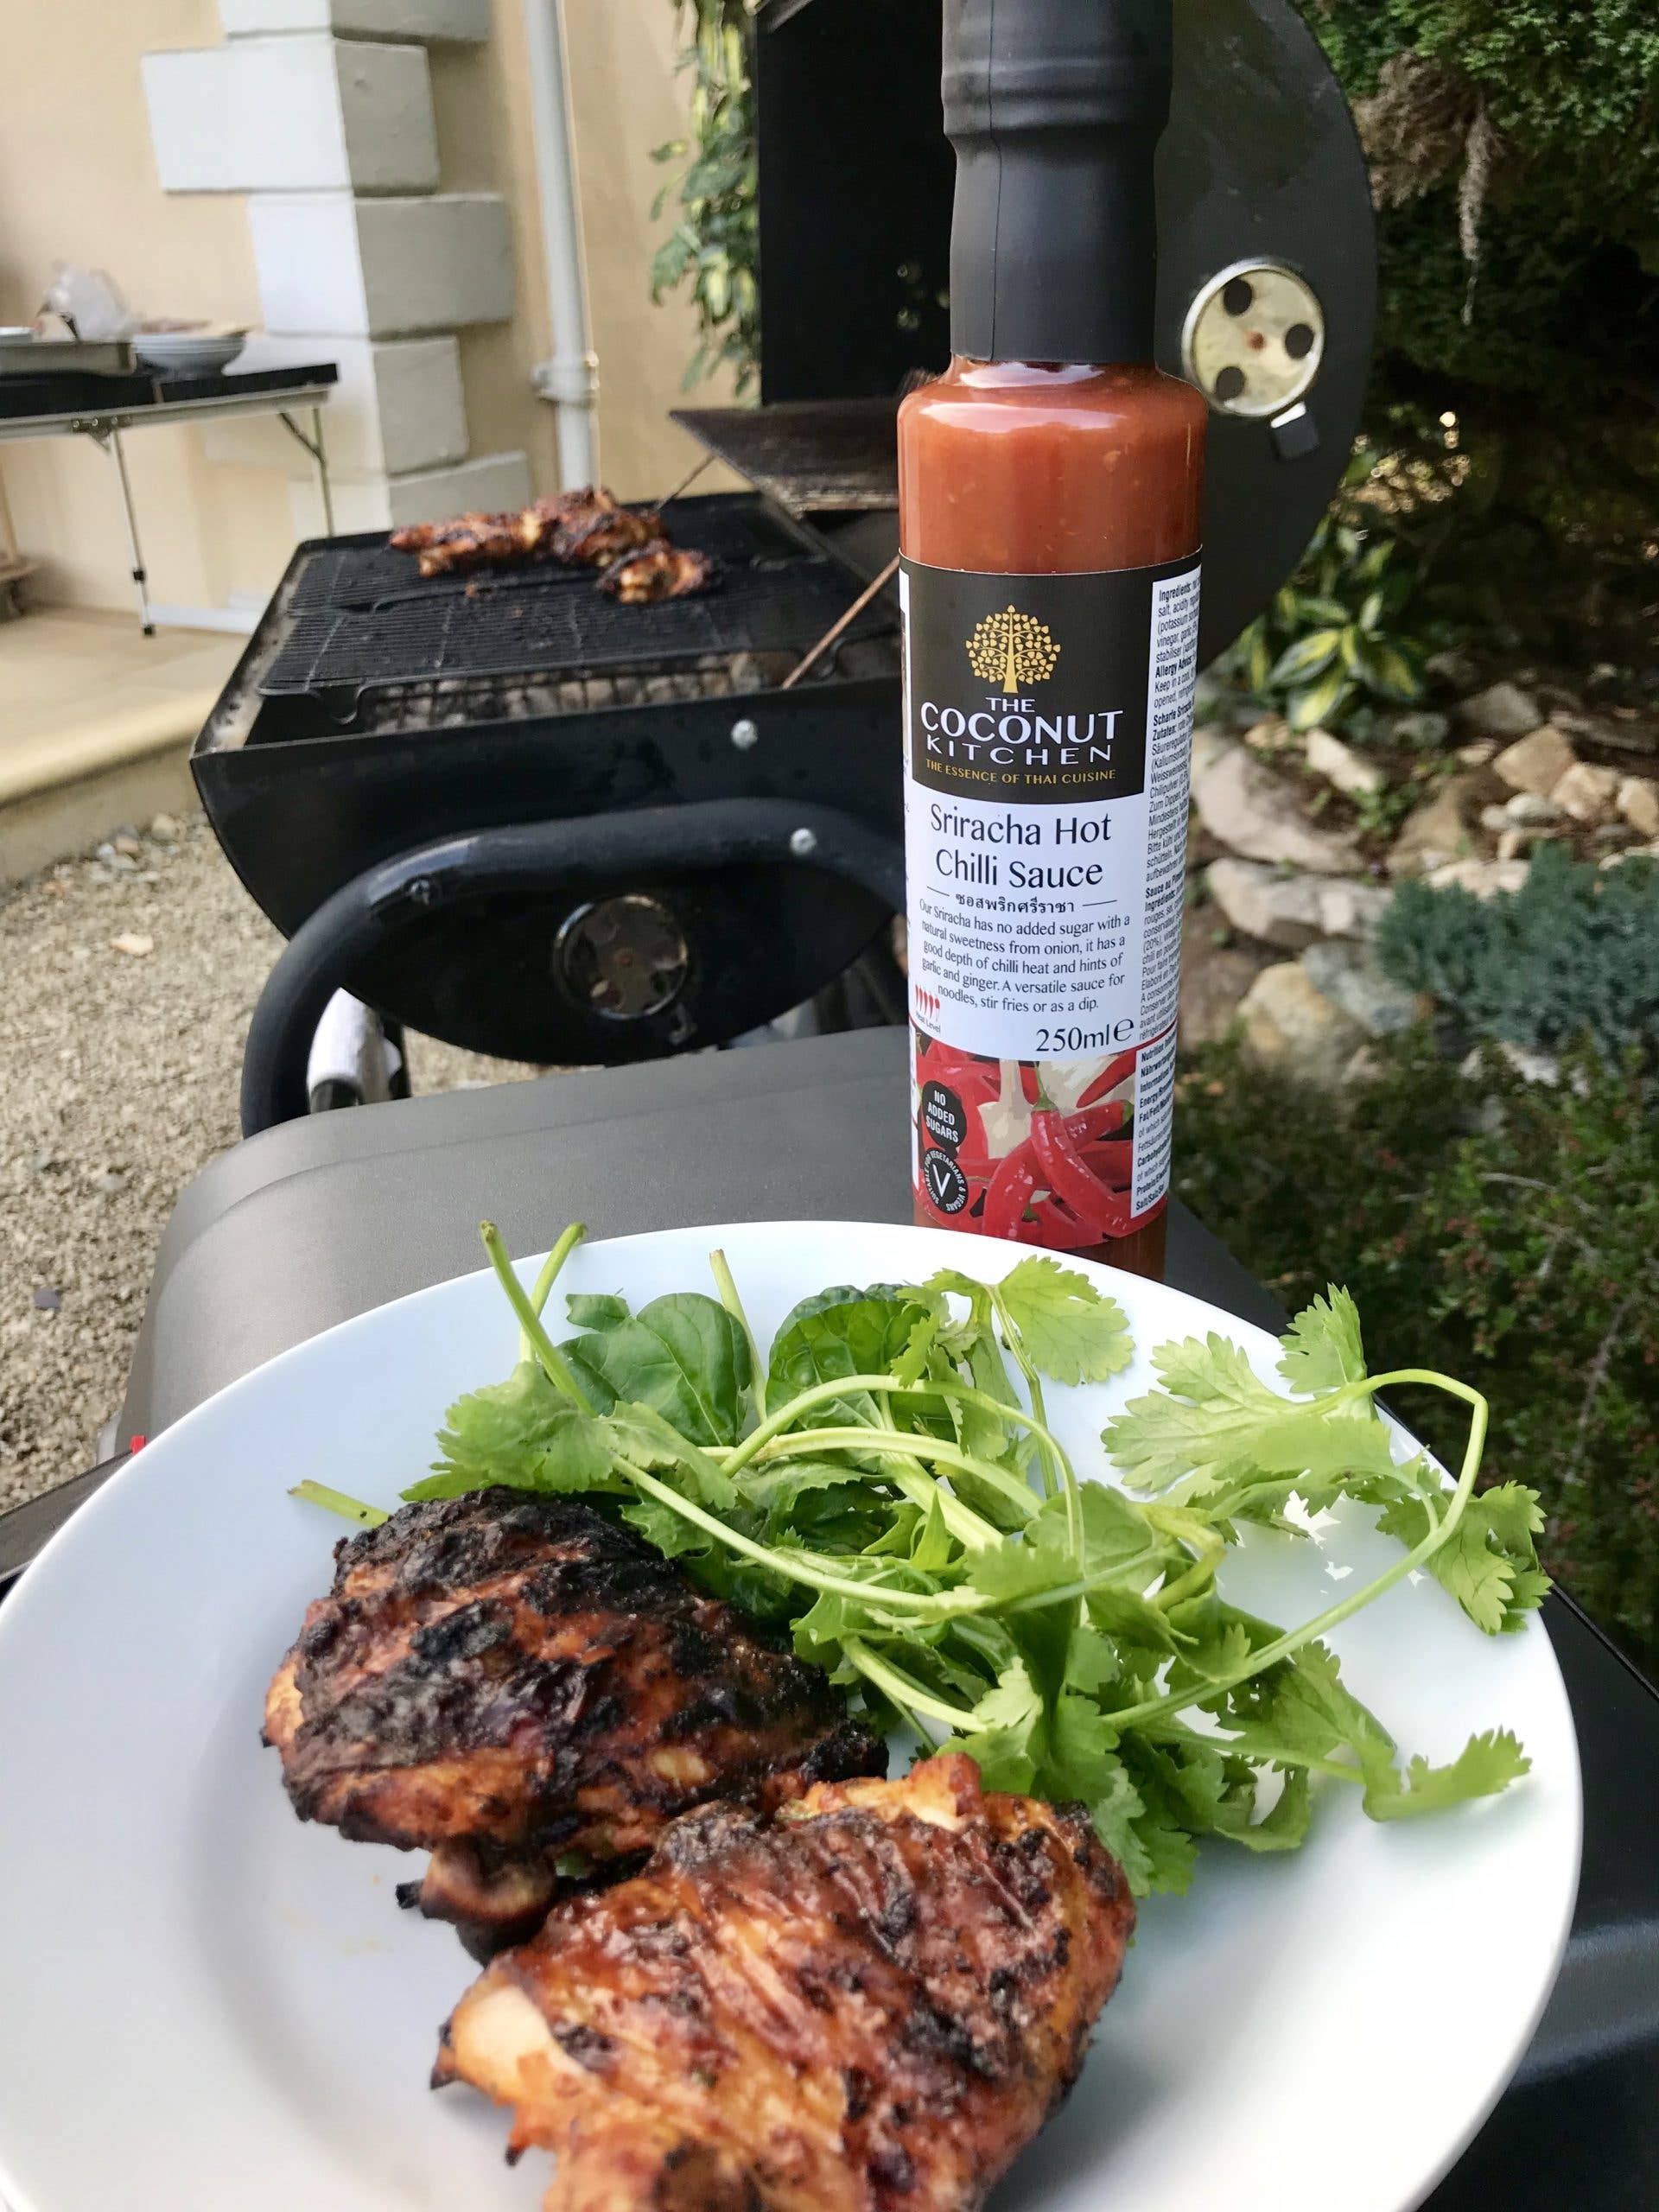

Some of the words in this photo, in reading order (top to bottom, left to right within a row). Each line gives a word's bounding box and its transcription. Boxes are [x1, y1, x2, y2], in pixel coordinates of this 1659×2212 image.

[985, 696, 1035, 712] THE
[920, 702, 1123, 744] COCONUT
[926, 734, 1112, 766] KITCHEN
[925, 759, 943, 772] THE
[945, 766, 997, 782] ESSENCE
[1001, 772, 1020, 784] OF
[1024, 773, 1057, 784] THAI
[1061, 769, 1116, 784] CUISINE
[931, 804, 1041, 845] Sriracha
[1056, 813, 1112, 844] Hot
[936, 849, 998, 886] Chilli
[1008, 861, 1103, 888] Sauce
[919, 899, 933, 914] Our
[933, 906, 971, 928] Sriracha
[974, 917, 993, 932] has
[997, 923, 1013, 934] no
[1016, 920, 1056, 936] added
[1059, 922, 1094, 938] sugar
[1097, 914, 1122, 931] with
[1124, 916, 1130, 926] a
[921, 919, 947, 940] natural
[949, 931, 1005, 953] sweetness
[1009, 940, 1040, 955] from
[1044, 939, 1083, 957] onion,
[1086, 938, 1094, 951] it
[1096, 935, 1116, 950] has
[1119, 936, 1125, 946] a
[923, 938, 943, 957] good
[944, 949, 973, 969] depth
[976, 955, 989, 969] of
[992, 957, 1019, 974] chilli
[1022, 959, 1049, 974] heat
[1052, 957, 1076, 974] and
[1079, 956, 1107, 972] hints
[1109, 952, 1124, 967] of
[921, 956, 942, 976] garlic
[943, 966, 960, 982] and
[962, 974, 1000, 993] ginger.
[1001, 981, 1011, 992] A
[1015, 977, 1067, 994] versatile
[1071, 979, 1105, 992] sauce
[1109, 973, 1126, 987] for
[938, 983, 978, 1008] noodles,
[981, 994, 998, 1009] stir
[1002, 998, 1029, 1013] fries
[1033, 1002, 1047, 1013] or
[1050, 1001, 1064, 1013] as
[1068, 1001, 1075, 1012] a
[1078, 995, 1098, 1014] dip.
[928, 1102, 955, 1126] ADDED
[934, 1090, 946, 1106] NO
[925, 1115, 959, 1143] SUGARS
[932, 1164, 951, 1198] V
